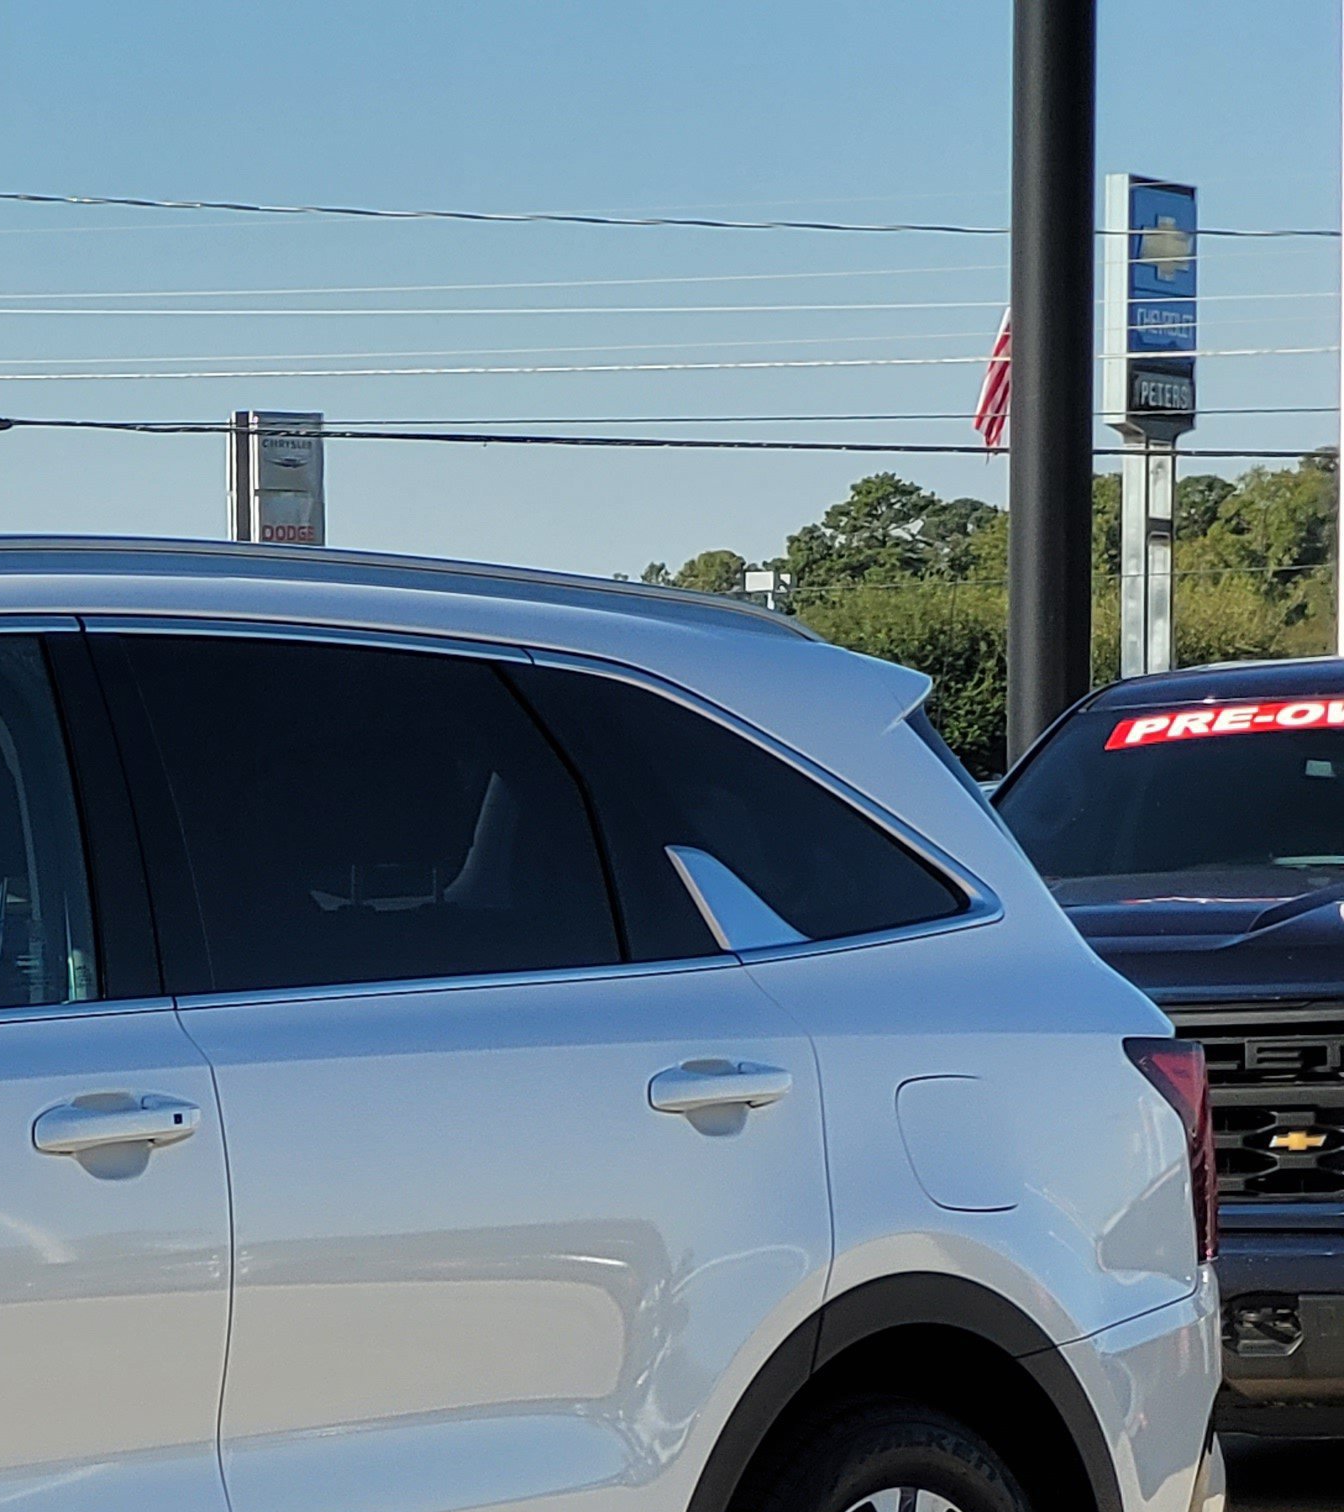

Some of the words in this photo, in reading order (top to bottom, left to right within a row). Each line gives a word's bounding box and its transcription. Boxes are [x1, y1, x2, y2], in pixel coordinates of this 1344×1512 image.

[1140, 381, 1189, 409] PETERS
[261, 524, 314, 541] DODGE
[1125, 702, 1344, 744] PRE-O
